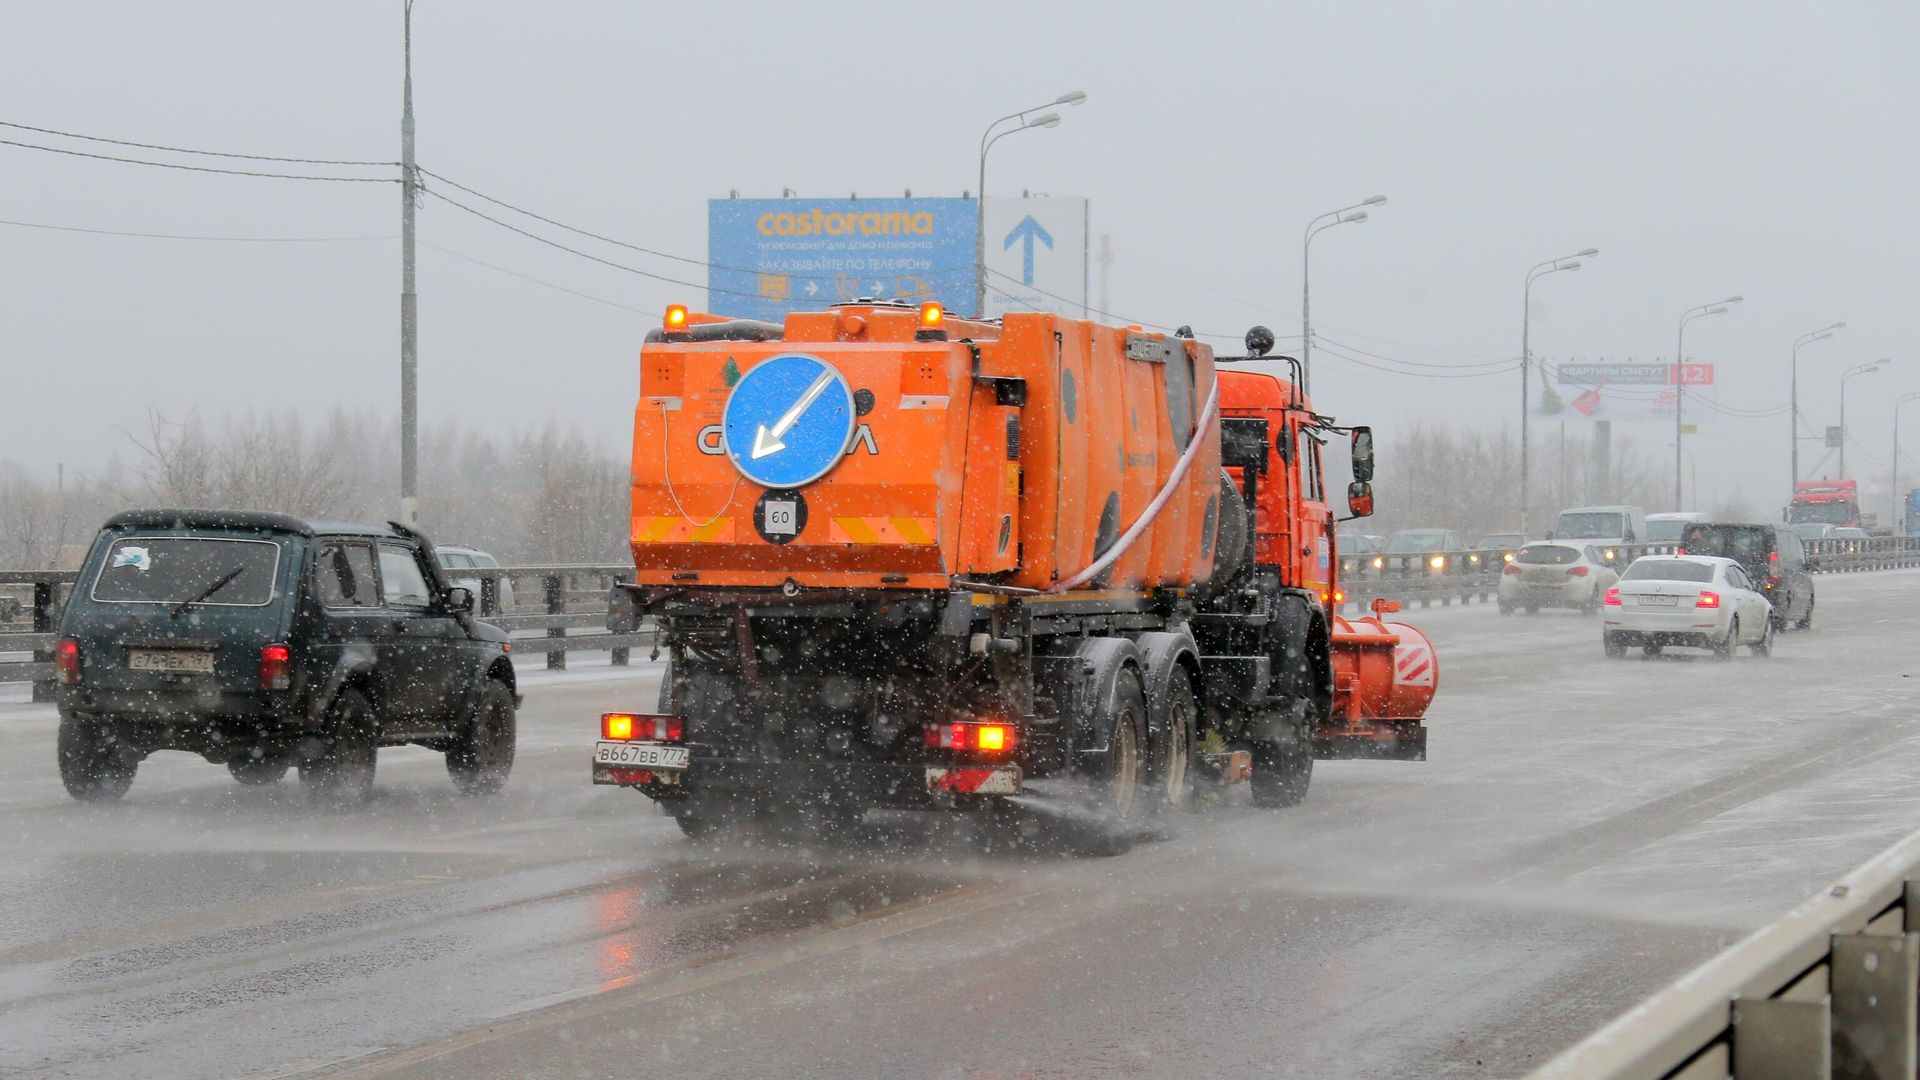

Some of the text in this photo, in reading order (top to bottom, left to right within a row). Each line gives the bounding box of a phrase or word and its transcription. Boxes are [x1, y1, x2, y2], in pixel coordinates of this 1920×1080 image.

[757, 208, 934, 236] castorama
[827, 241, 845, 250] для
[848, 241, 876, 250] дома
[887, 241, 933, 250] ремонта
[758, 257, 932, 271] ЗАКАЗЫВАЙТЕ ПО ТЕЛЕФОНУ
[1561, 367, 1619, 376] КВАРТИРЫ
[1622, 367, 1663, 376] СМЕТУТ
[771, 511, 790, 525] 60
[662, 748, 685, 761] 777
